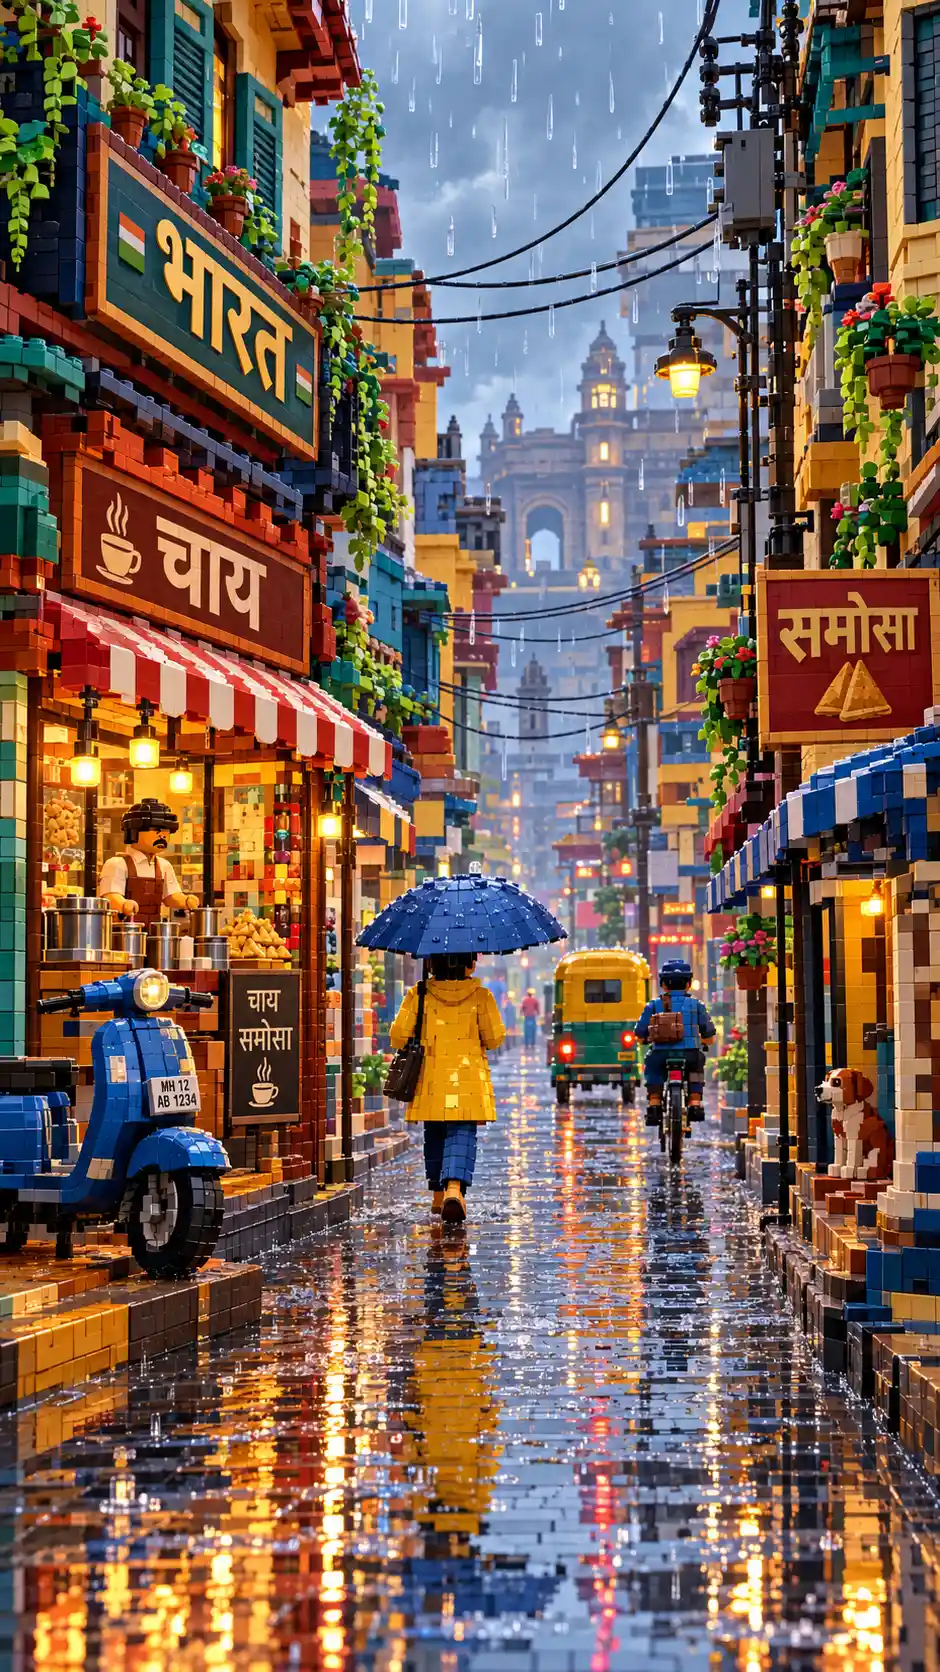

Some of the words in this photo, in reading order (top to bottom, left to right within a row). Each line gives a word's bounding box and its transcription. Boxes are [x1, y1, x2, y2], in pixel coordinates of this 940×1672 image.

[157, 219, 293, 403] भारत
[156, 515, 267, 632] चाय
[778, 591, 919, 663] समोसा
[246, 989, 281, 1013] चाय
[238, 1018, 293, 1052] समोसा
[157, 1095, 170, 1108] AB
[173, 1093, 197, 1107] 1234
[161, 1080, 175, 1092] MH
[178, 1079, 190, 1091] 12
